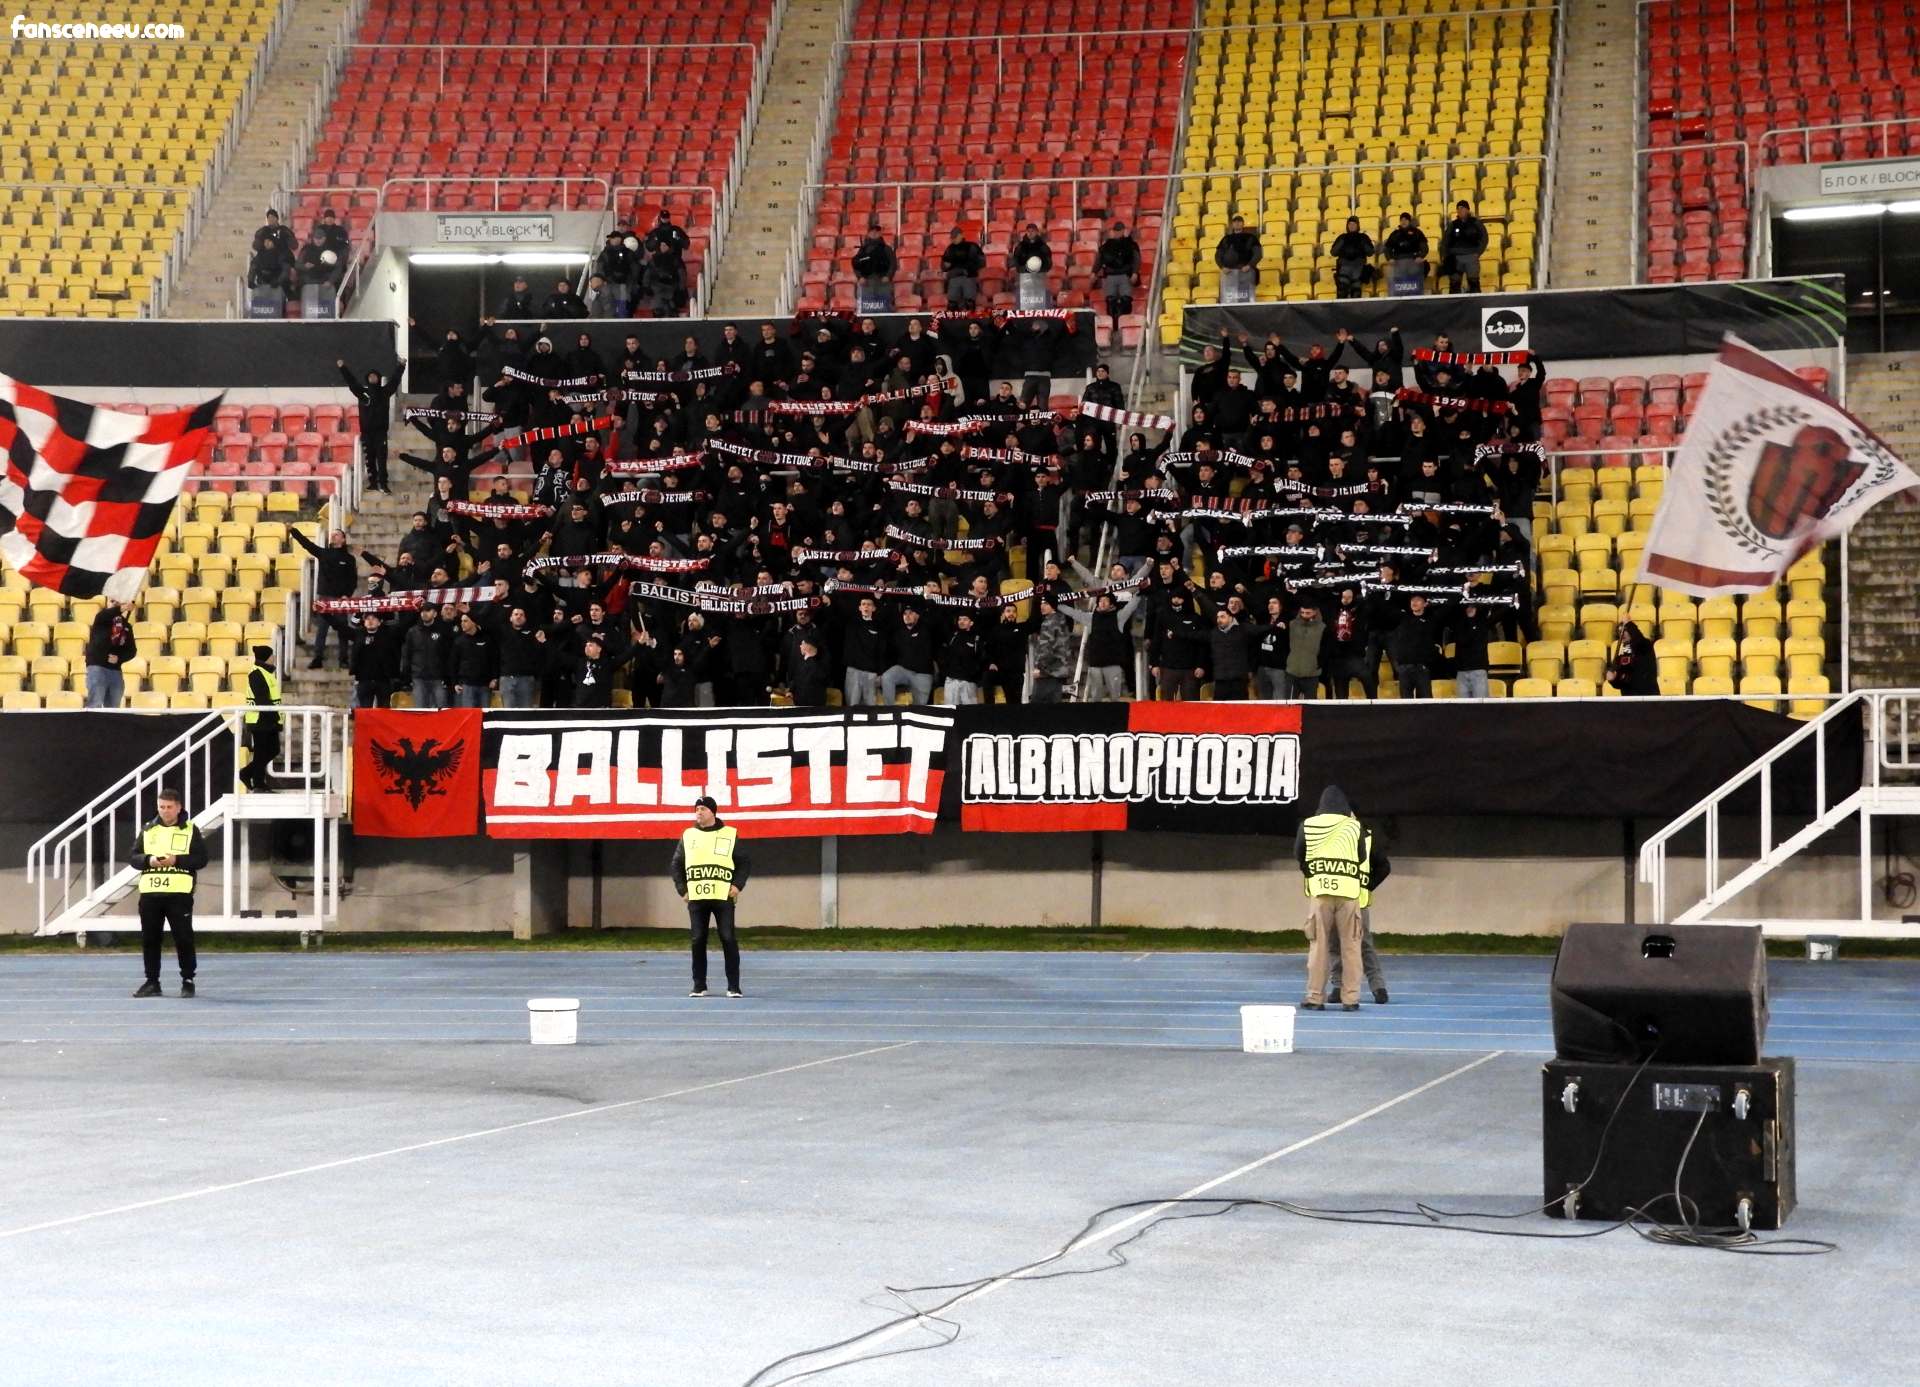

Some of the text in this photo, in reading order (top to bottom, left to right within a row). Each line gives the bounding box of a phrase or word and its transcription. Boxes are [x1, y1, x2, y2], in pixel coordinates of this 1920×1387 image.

[444, 226, 482, 236] БЛОК
[492, 225, 531, 236] BLOCK
[1433, 395, 1467, 409] 1979
[493, 713, 946, 807] BALLISTËT
[967, 735, 1298, 801] ALBANOPHOBIA
[149, 877, 170, 888] 194
[1318, 878, 1339, 890] 185
[695, 883, 716, 895] 061
